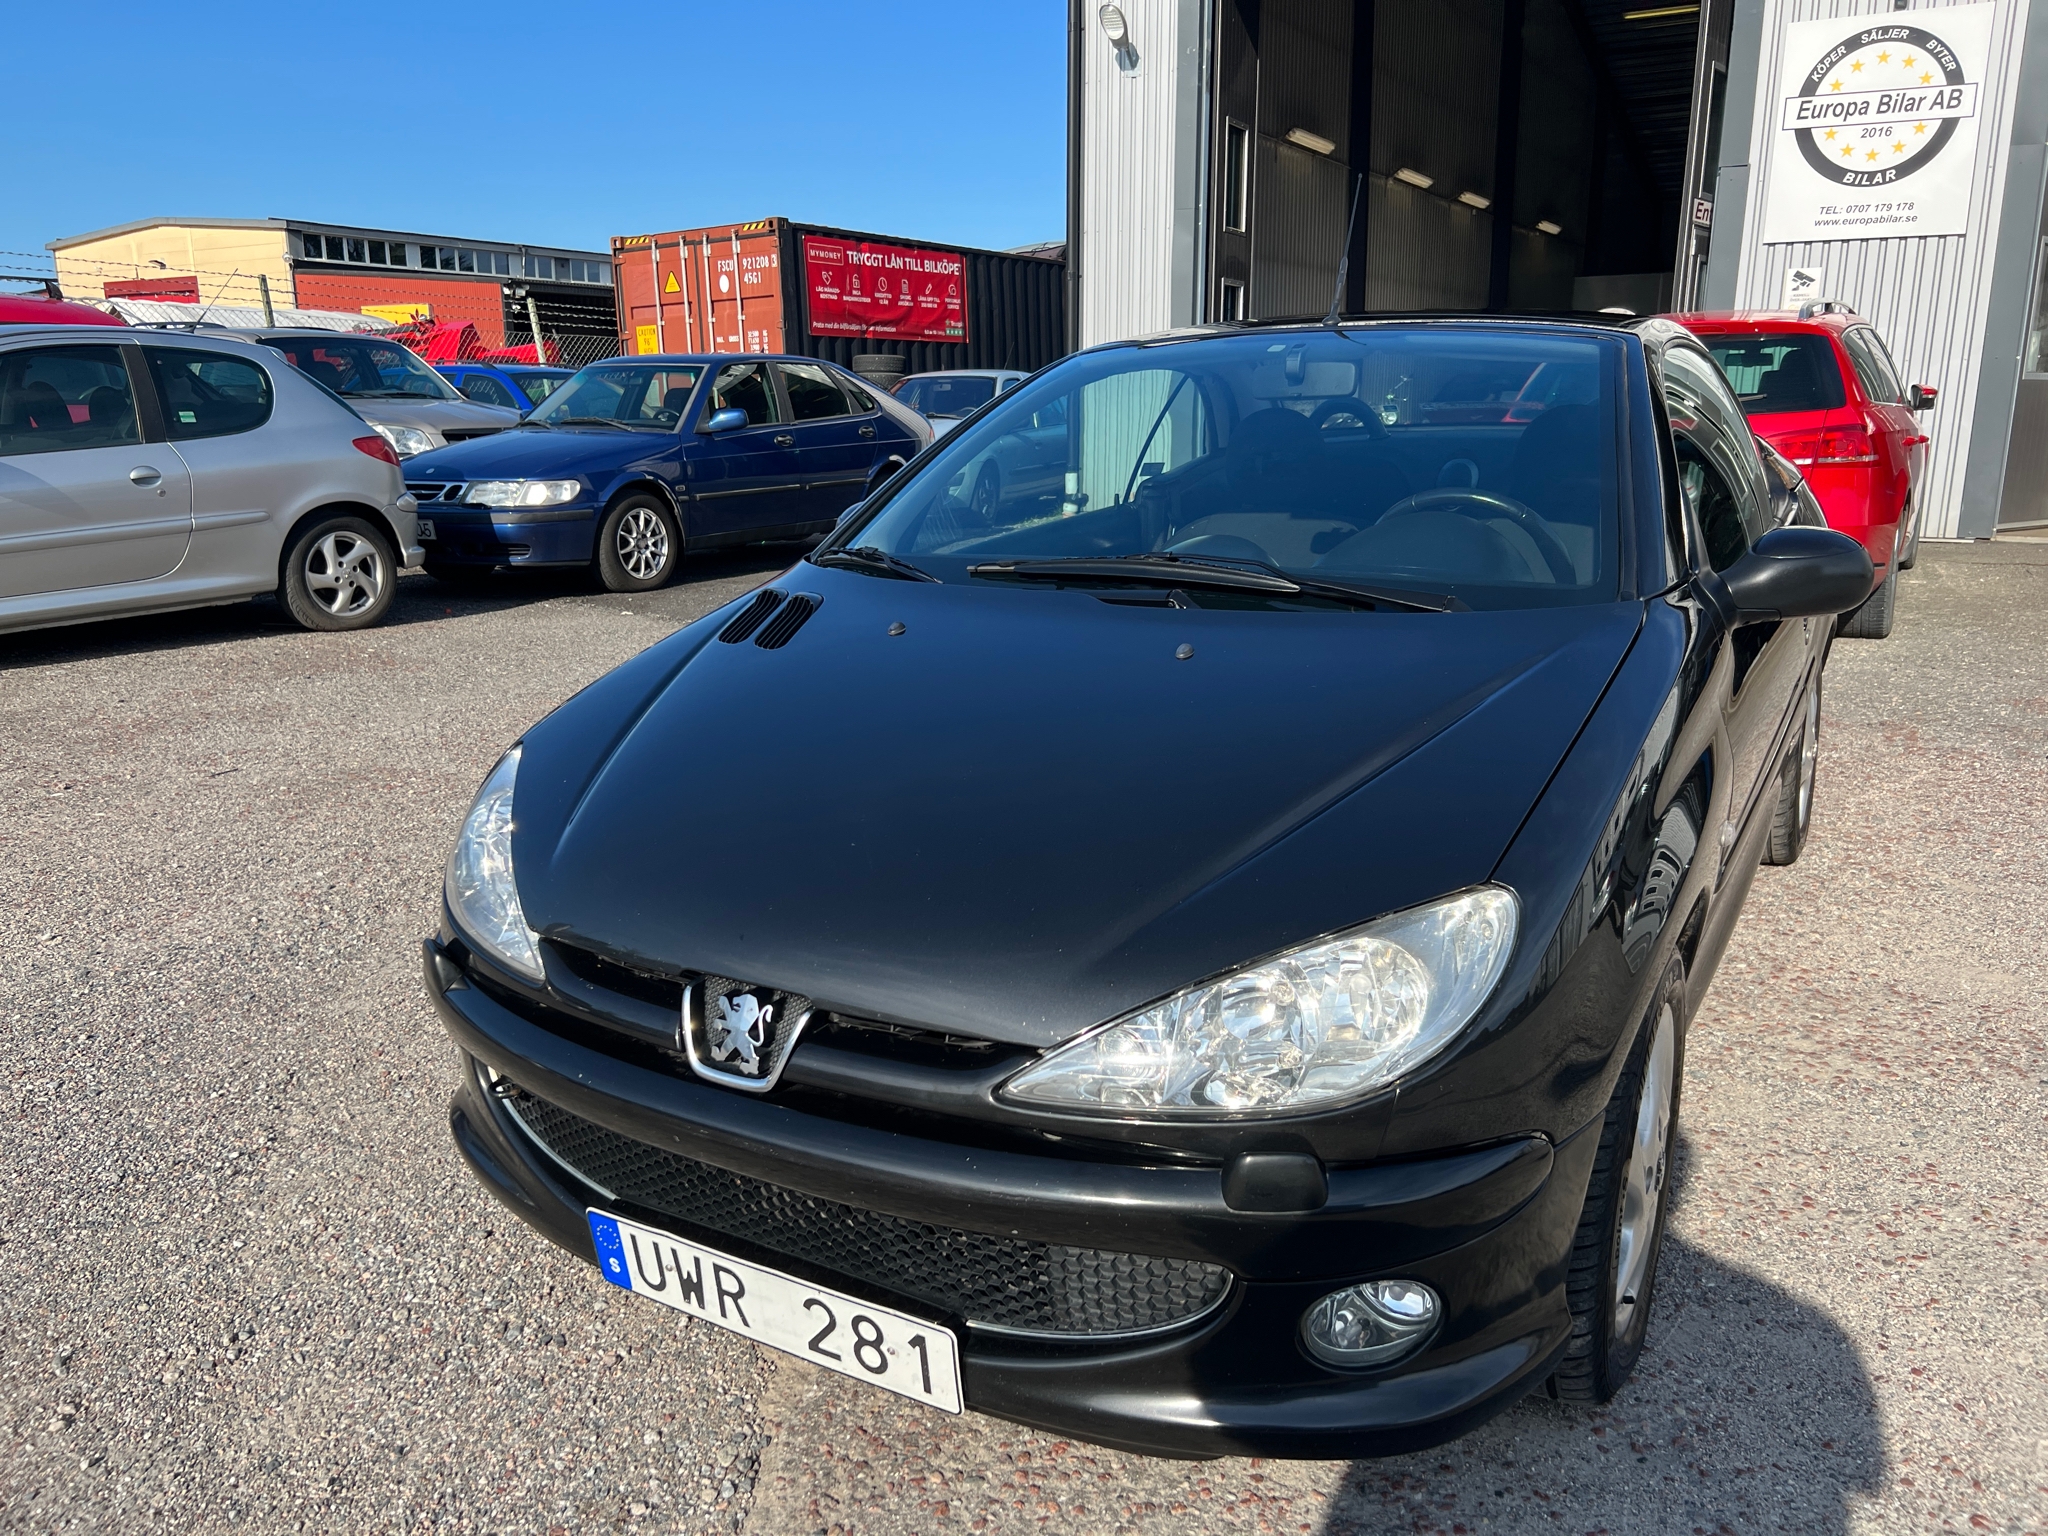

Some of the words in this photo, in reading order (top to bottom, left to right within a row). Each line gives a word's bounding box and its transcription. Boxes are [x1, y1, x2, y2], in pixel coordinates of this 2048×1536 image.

[1811, 45, 1847, 83] KÖPER
[1861, 28, 1910, 44] SÄLJER
[1925, 39, 1956, 72] BYTER
[1796, 99, 1870, 122] Europa
[1876, 92, 1927, 115] Bilar
[1929, 88, 1963, 111] AB
[1860, 126, 1893, 139] 2016
[1842, 169, 1897, 185] BILAR
[1819, 206, 1843, 215] TEL:
[1846, 204, 1871, 213] 0707
[1874, 203, 1893, 212] 179
[1896, 202, 1915, 211] 178
[1814, 214, 1918, 226] www.europabilar.se
[810, 249, 841, 260] MYMONEY
[846, 250, 884, 267] TRYGGT
[885, 253, 903, 269] LÅN
[904, 257, 923, 272] TILL
[717, 259, 734, 272] FSCU
[742, 255, 769, 270] 921208
[744, 272, 761, 284] 45G1
[638, 327, 656, 337] CAUTION
[608, 1256, 621, 1274] S
[629, 1232, 750, 1328] UWR
[802, 1297, 933, 1394] 281
